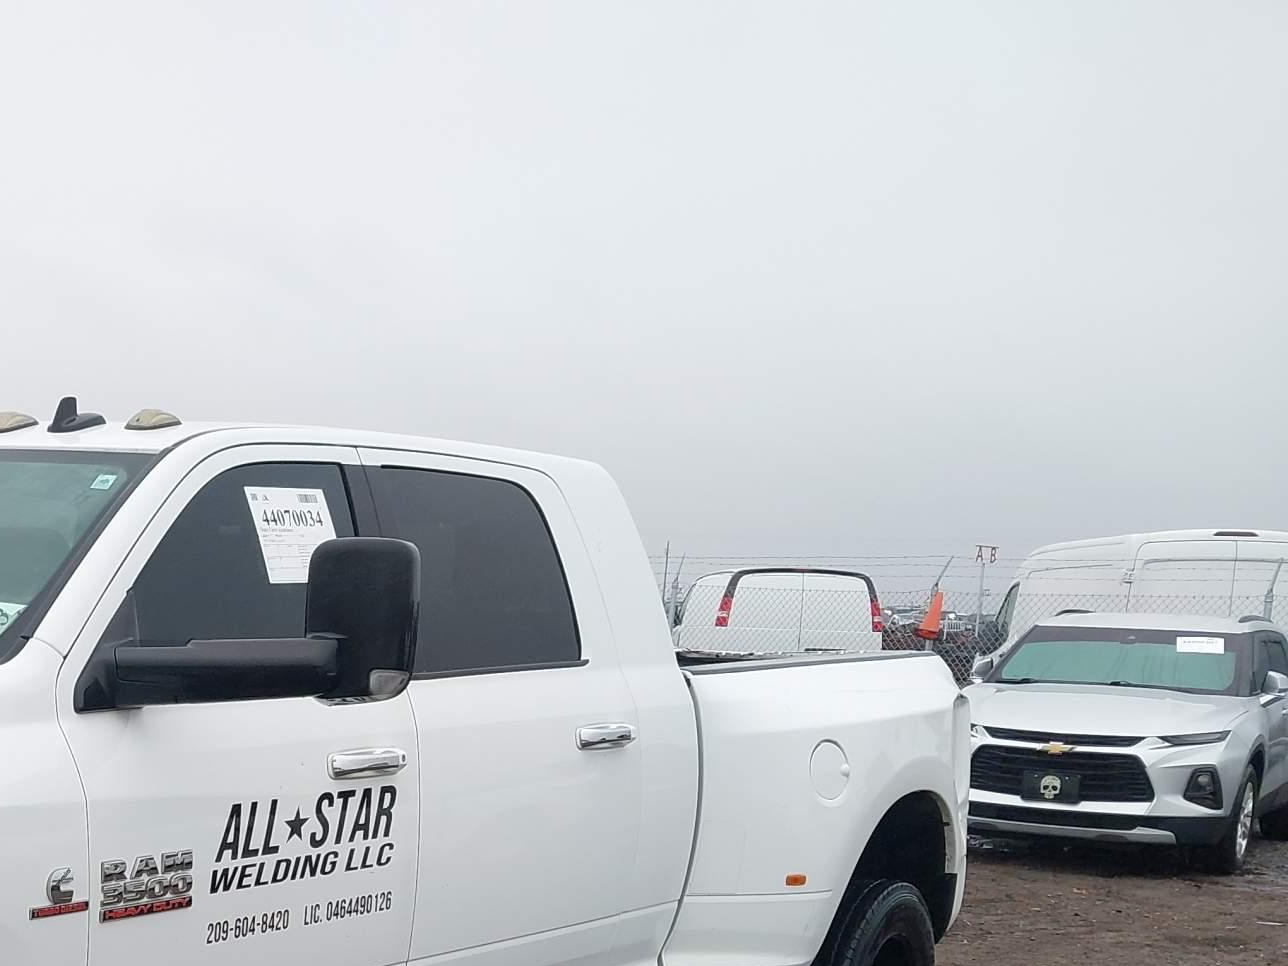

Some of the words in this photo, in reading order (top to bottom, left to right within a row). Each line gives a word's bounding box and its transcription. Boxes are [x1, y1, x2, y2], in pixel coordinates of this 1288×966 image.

[261, 508, 323, 527] 44070034
[975, 546, 983, 562] A
[990, 546, 997, 563] B
[214, 798, 280, 863] ALL
[310, 785, 397, 848] STAR
[101, 850, 193, 883] RAM
[210, 850, 339, 894] WELDING
[344, 842, 394, 873] LLC
[100, 873, 193, 907] 3500
[105, 904, 151, 919] HEAVY
[152, 898, 190, 912] DUTY
[206, 909, 290, 944] 209-604-8420
[304, 904, 323, 926] LIC.
[326, 891, 392, 921] 0464490126
